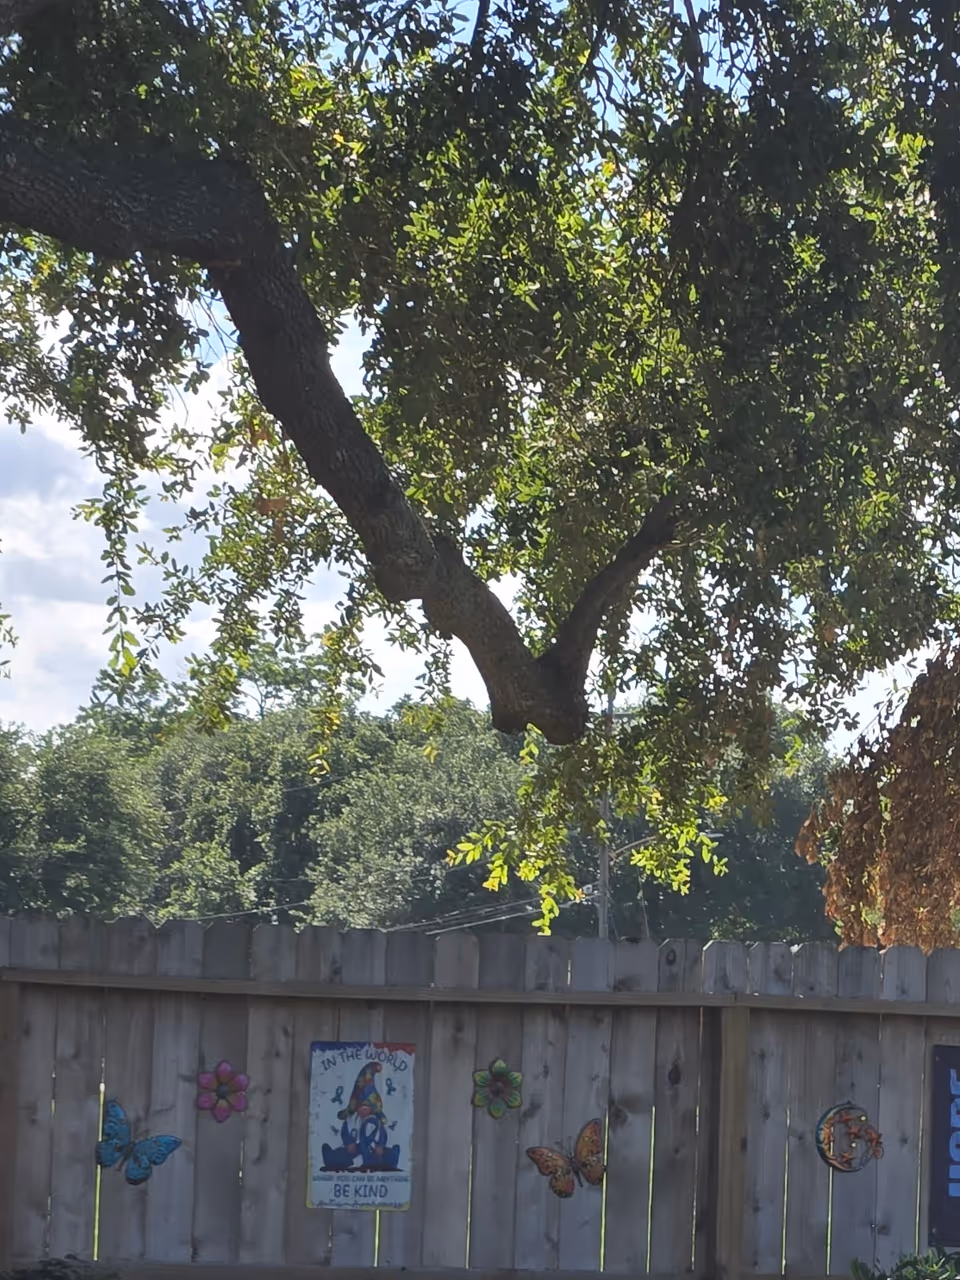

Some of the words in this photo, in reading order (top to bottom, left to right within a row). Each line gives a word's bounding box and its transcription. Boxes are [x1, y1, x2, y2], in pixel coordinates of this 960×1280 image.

[320, 1056, 336, 1071] IN
[339, 1050, 362, 1063] THE
[365, 1049, 408, 1072] WORLD
[333, 1184, 351, 1198] BE
[354, 1184, 388, 1198] KIND
